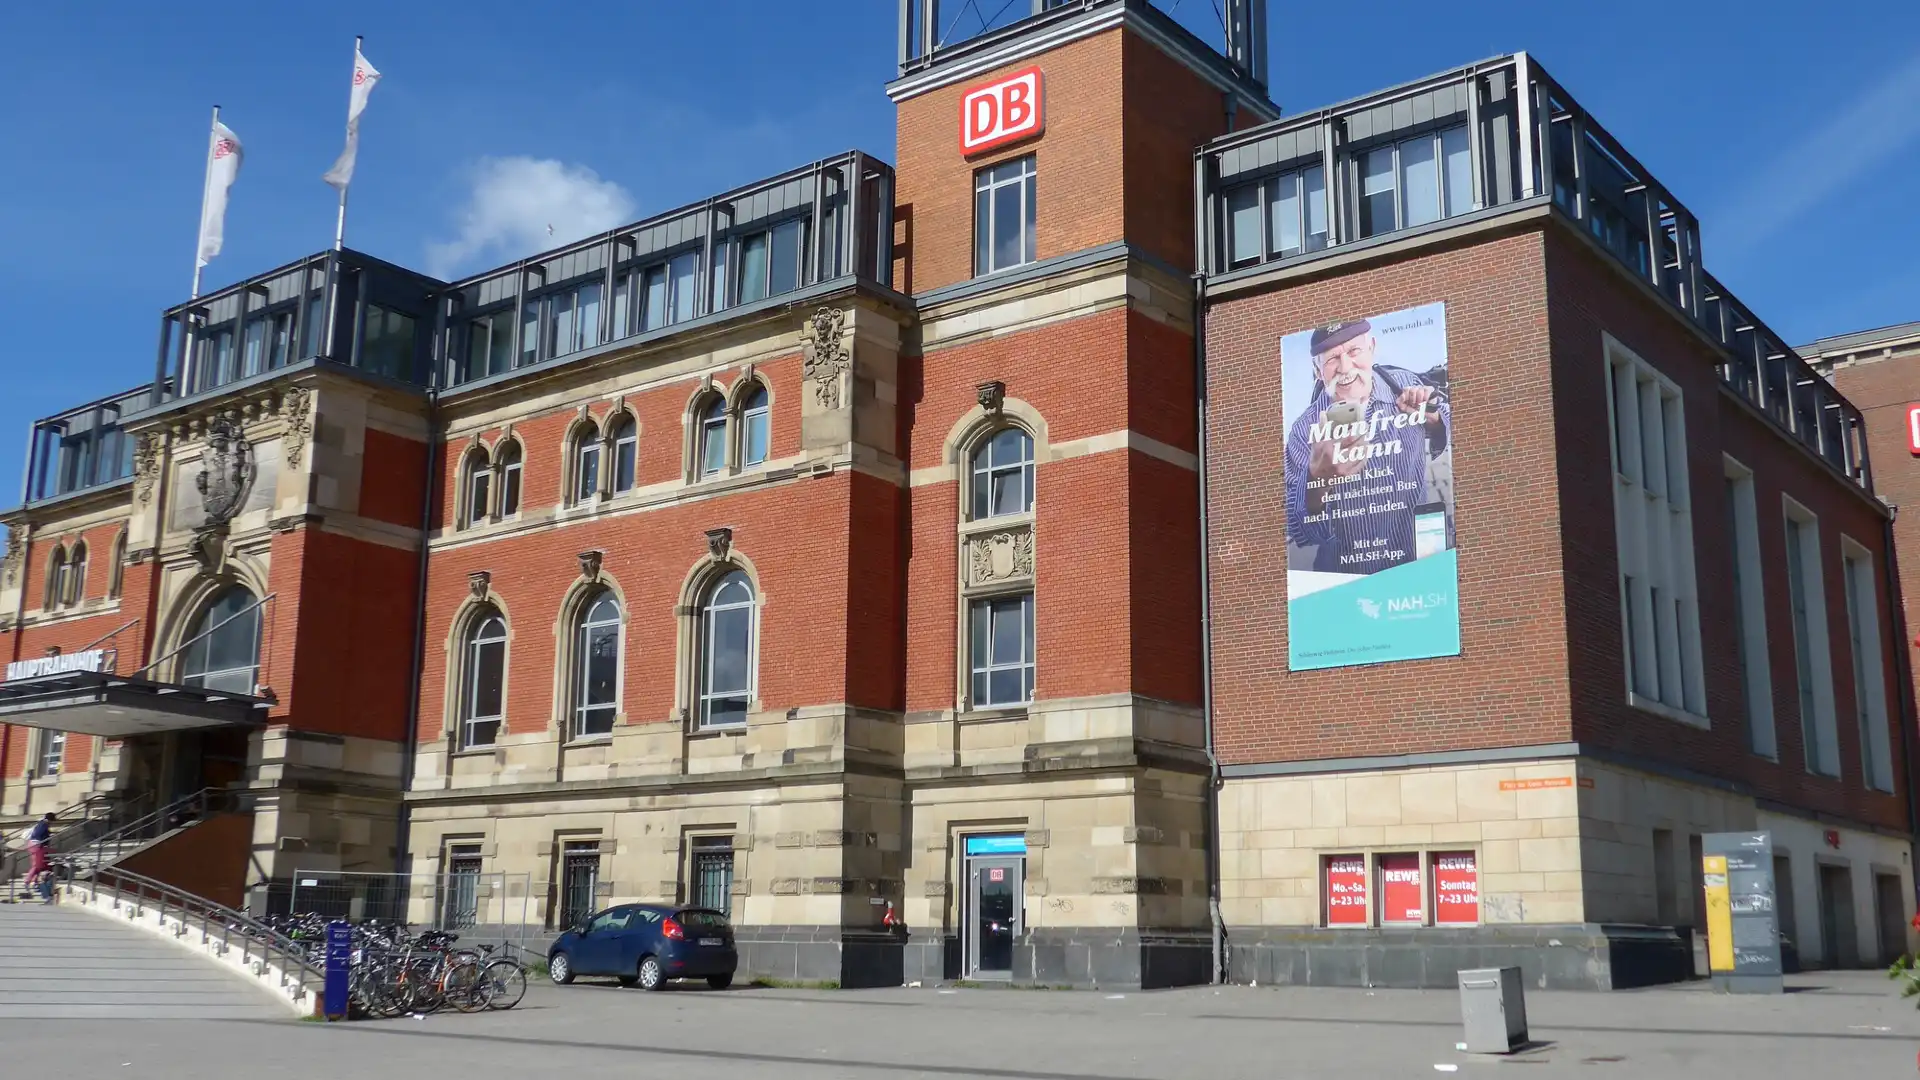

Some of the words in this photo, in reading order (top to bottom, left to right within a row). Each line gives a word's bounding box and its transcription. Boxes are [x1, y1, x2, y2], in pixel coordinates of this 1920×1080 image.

[970, 81, 1031, 141] DB
[1381, 317, 1434, 335] www.nah.sh
[1307, 401, 1428, 444] Manfred
[1332, 439, 1403, 465] kann
[1307, 477, 1326, 490] mit
[1328, 473, 1361, 486] einem
[1363, 465, 1395, 480] Klick
[1320, 488, 1341, 503] den
[1344, 484, 1393, 500] nächsten
[1397, 480, 1418, 492] Bus
[1303, 510, 1329, 524] nach
[1332, 507, 1366, 520] Hause
[1369, 500, 1408, 514] finden.
[1353, 539, 1370, 550] Mit
[1372, 537, 1388, 547] der
[1340, 549, 1406, 564] NAH.SH-App.
[1388, 590, 1447, 613] NAH.SH
[6, 649, 104, 681] HAUPTBAHNHOF
[1332, 861, 1364, 872] REWE
[1385, 870, 1419, 881] REWE
[1439, 858, 1474, 870] REWE
[1440, 880, 1476, 892] Sonntag
